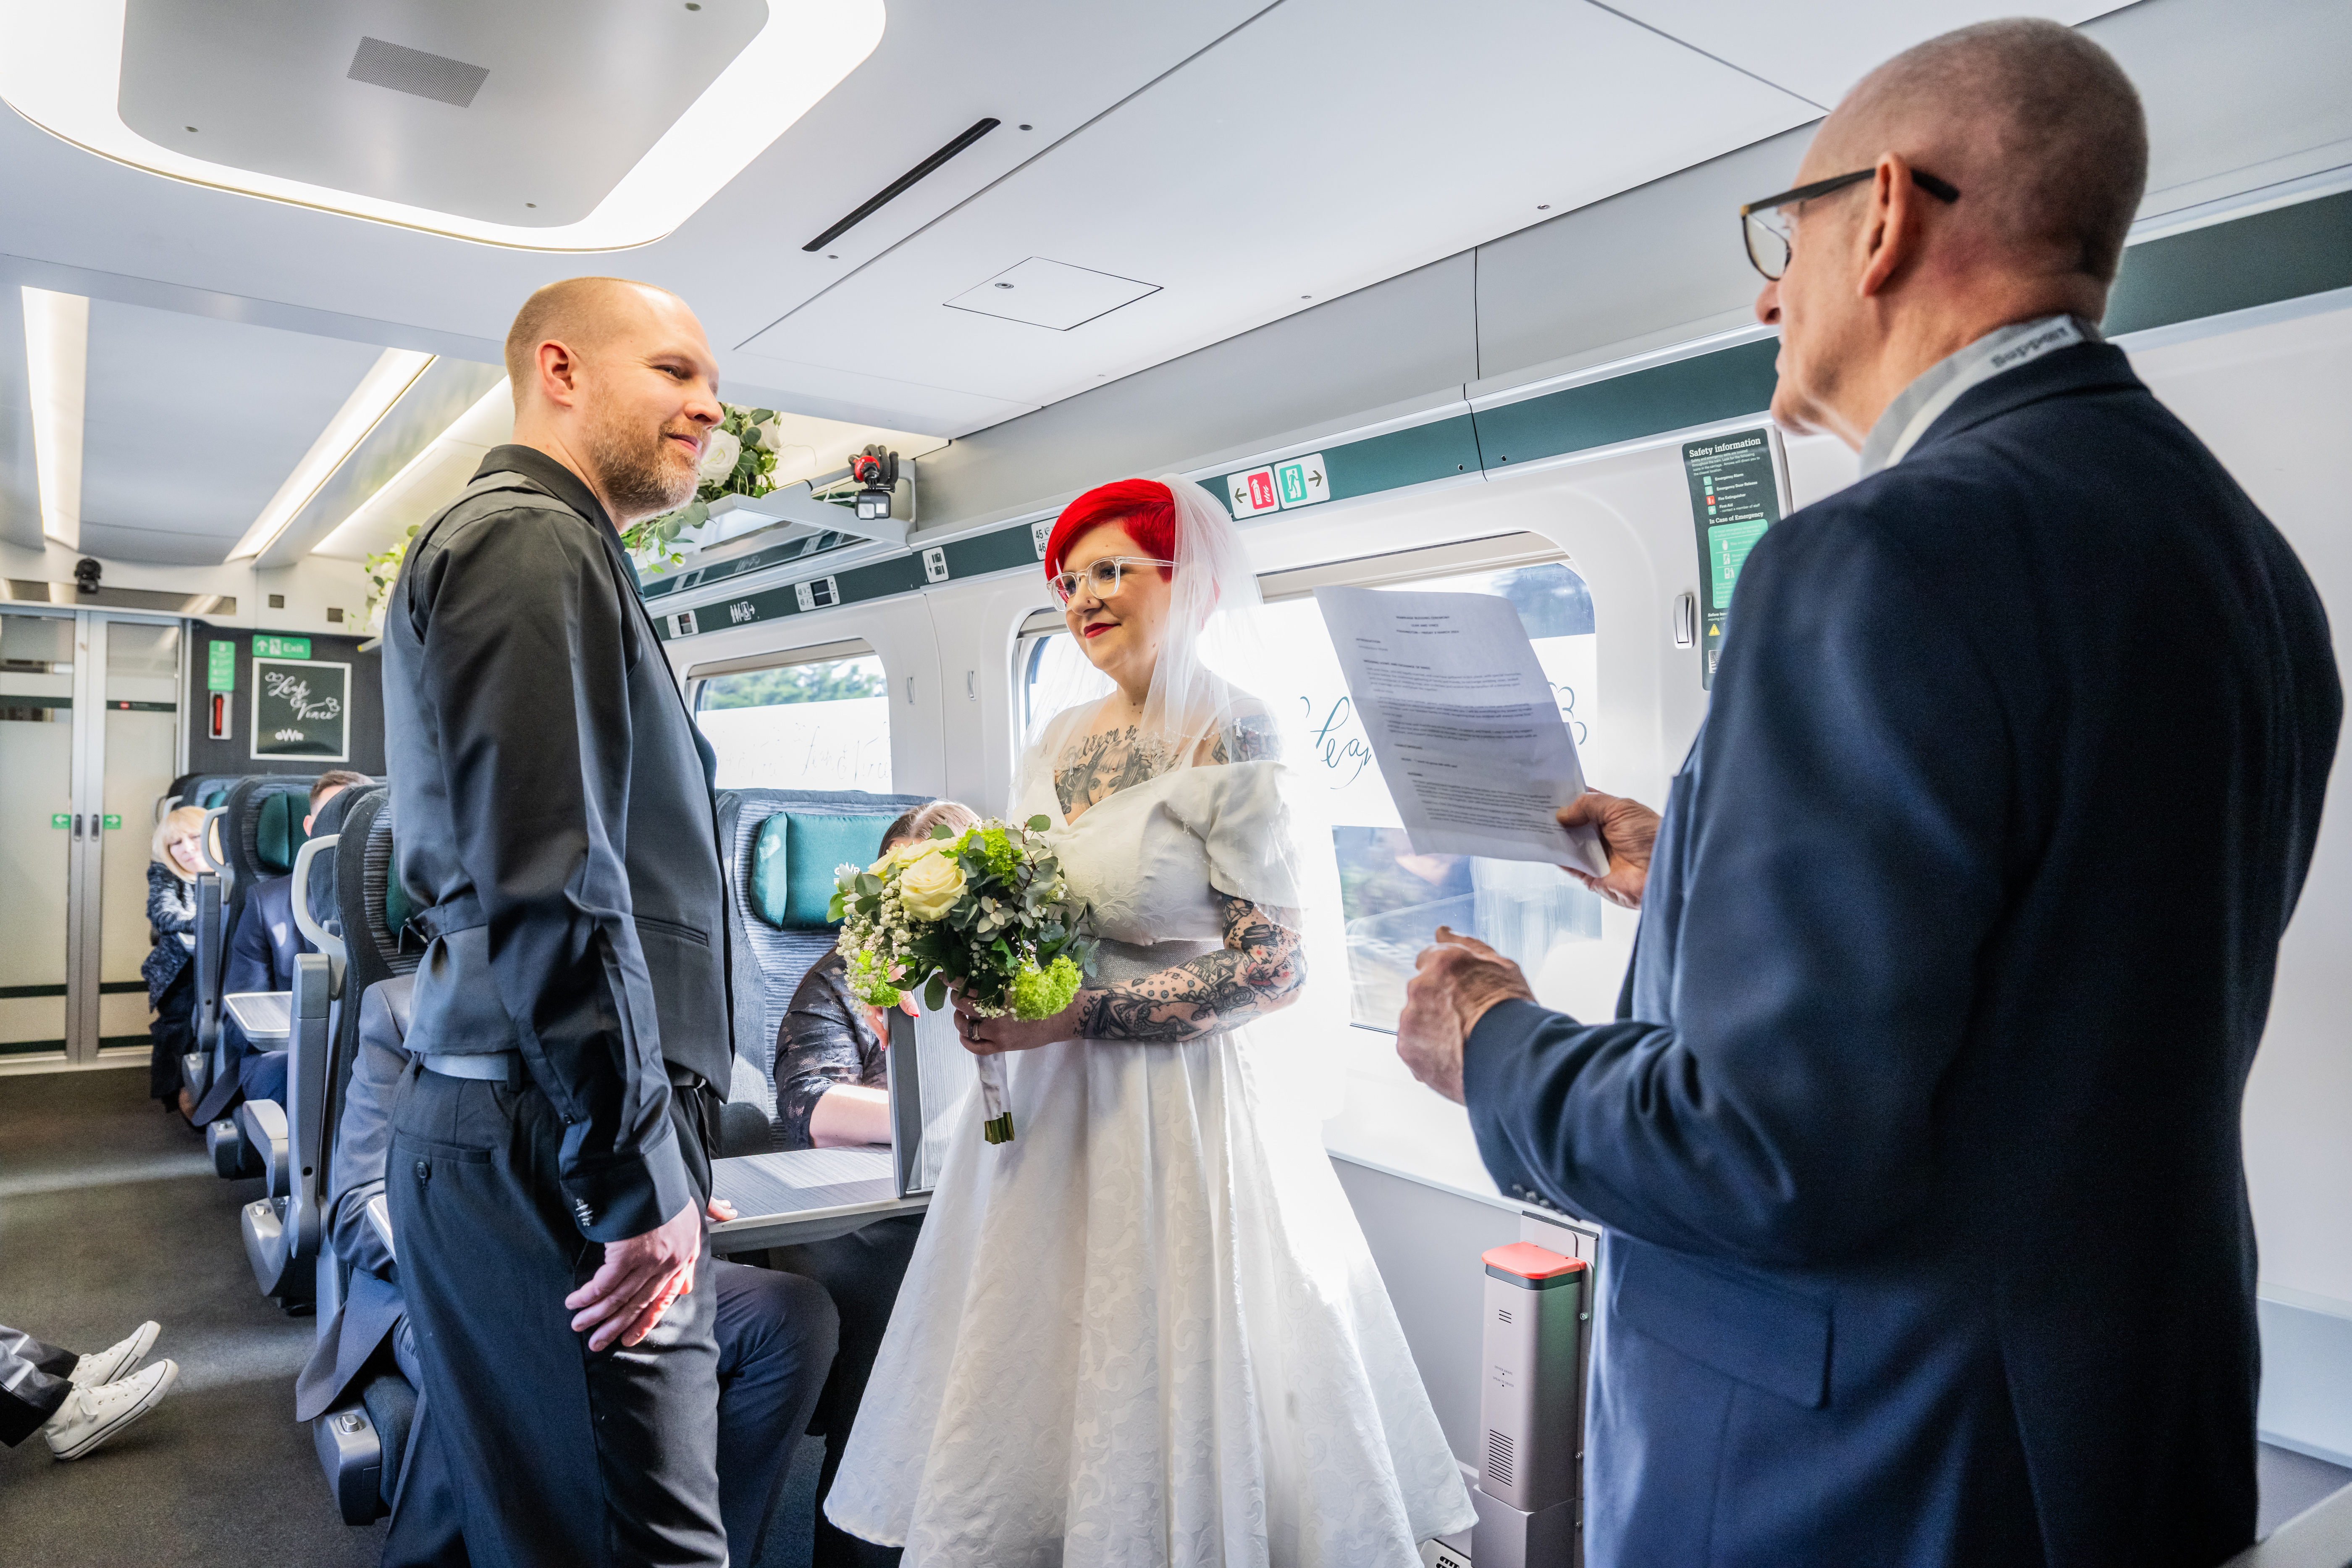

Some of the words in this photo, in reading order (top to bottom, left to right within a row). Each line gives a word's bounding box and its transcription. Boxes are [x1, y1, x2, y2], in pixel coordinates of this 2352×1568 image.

[1689, 447, 1713, 457] Safety
[1715, 438, 1761, 453] information
[1735, 512, 1764, 520] Emergency
[1036, 529, 1043, 539] 45
[1039, 543, 1046, 553] 46
[283, 642, 304, 653] Exit
[268, 675, 311, 699] Leah
[297, 702, 338, 721] Vince
[275, 728, 304, 742] GWR
